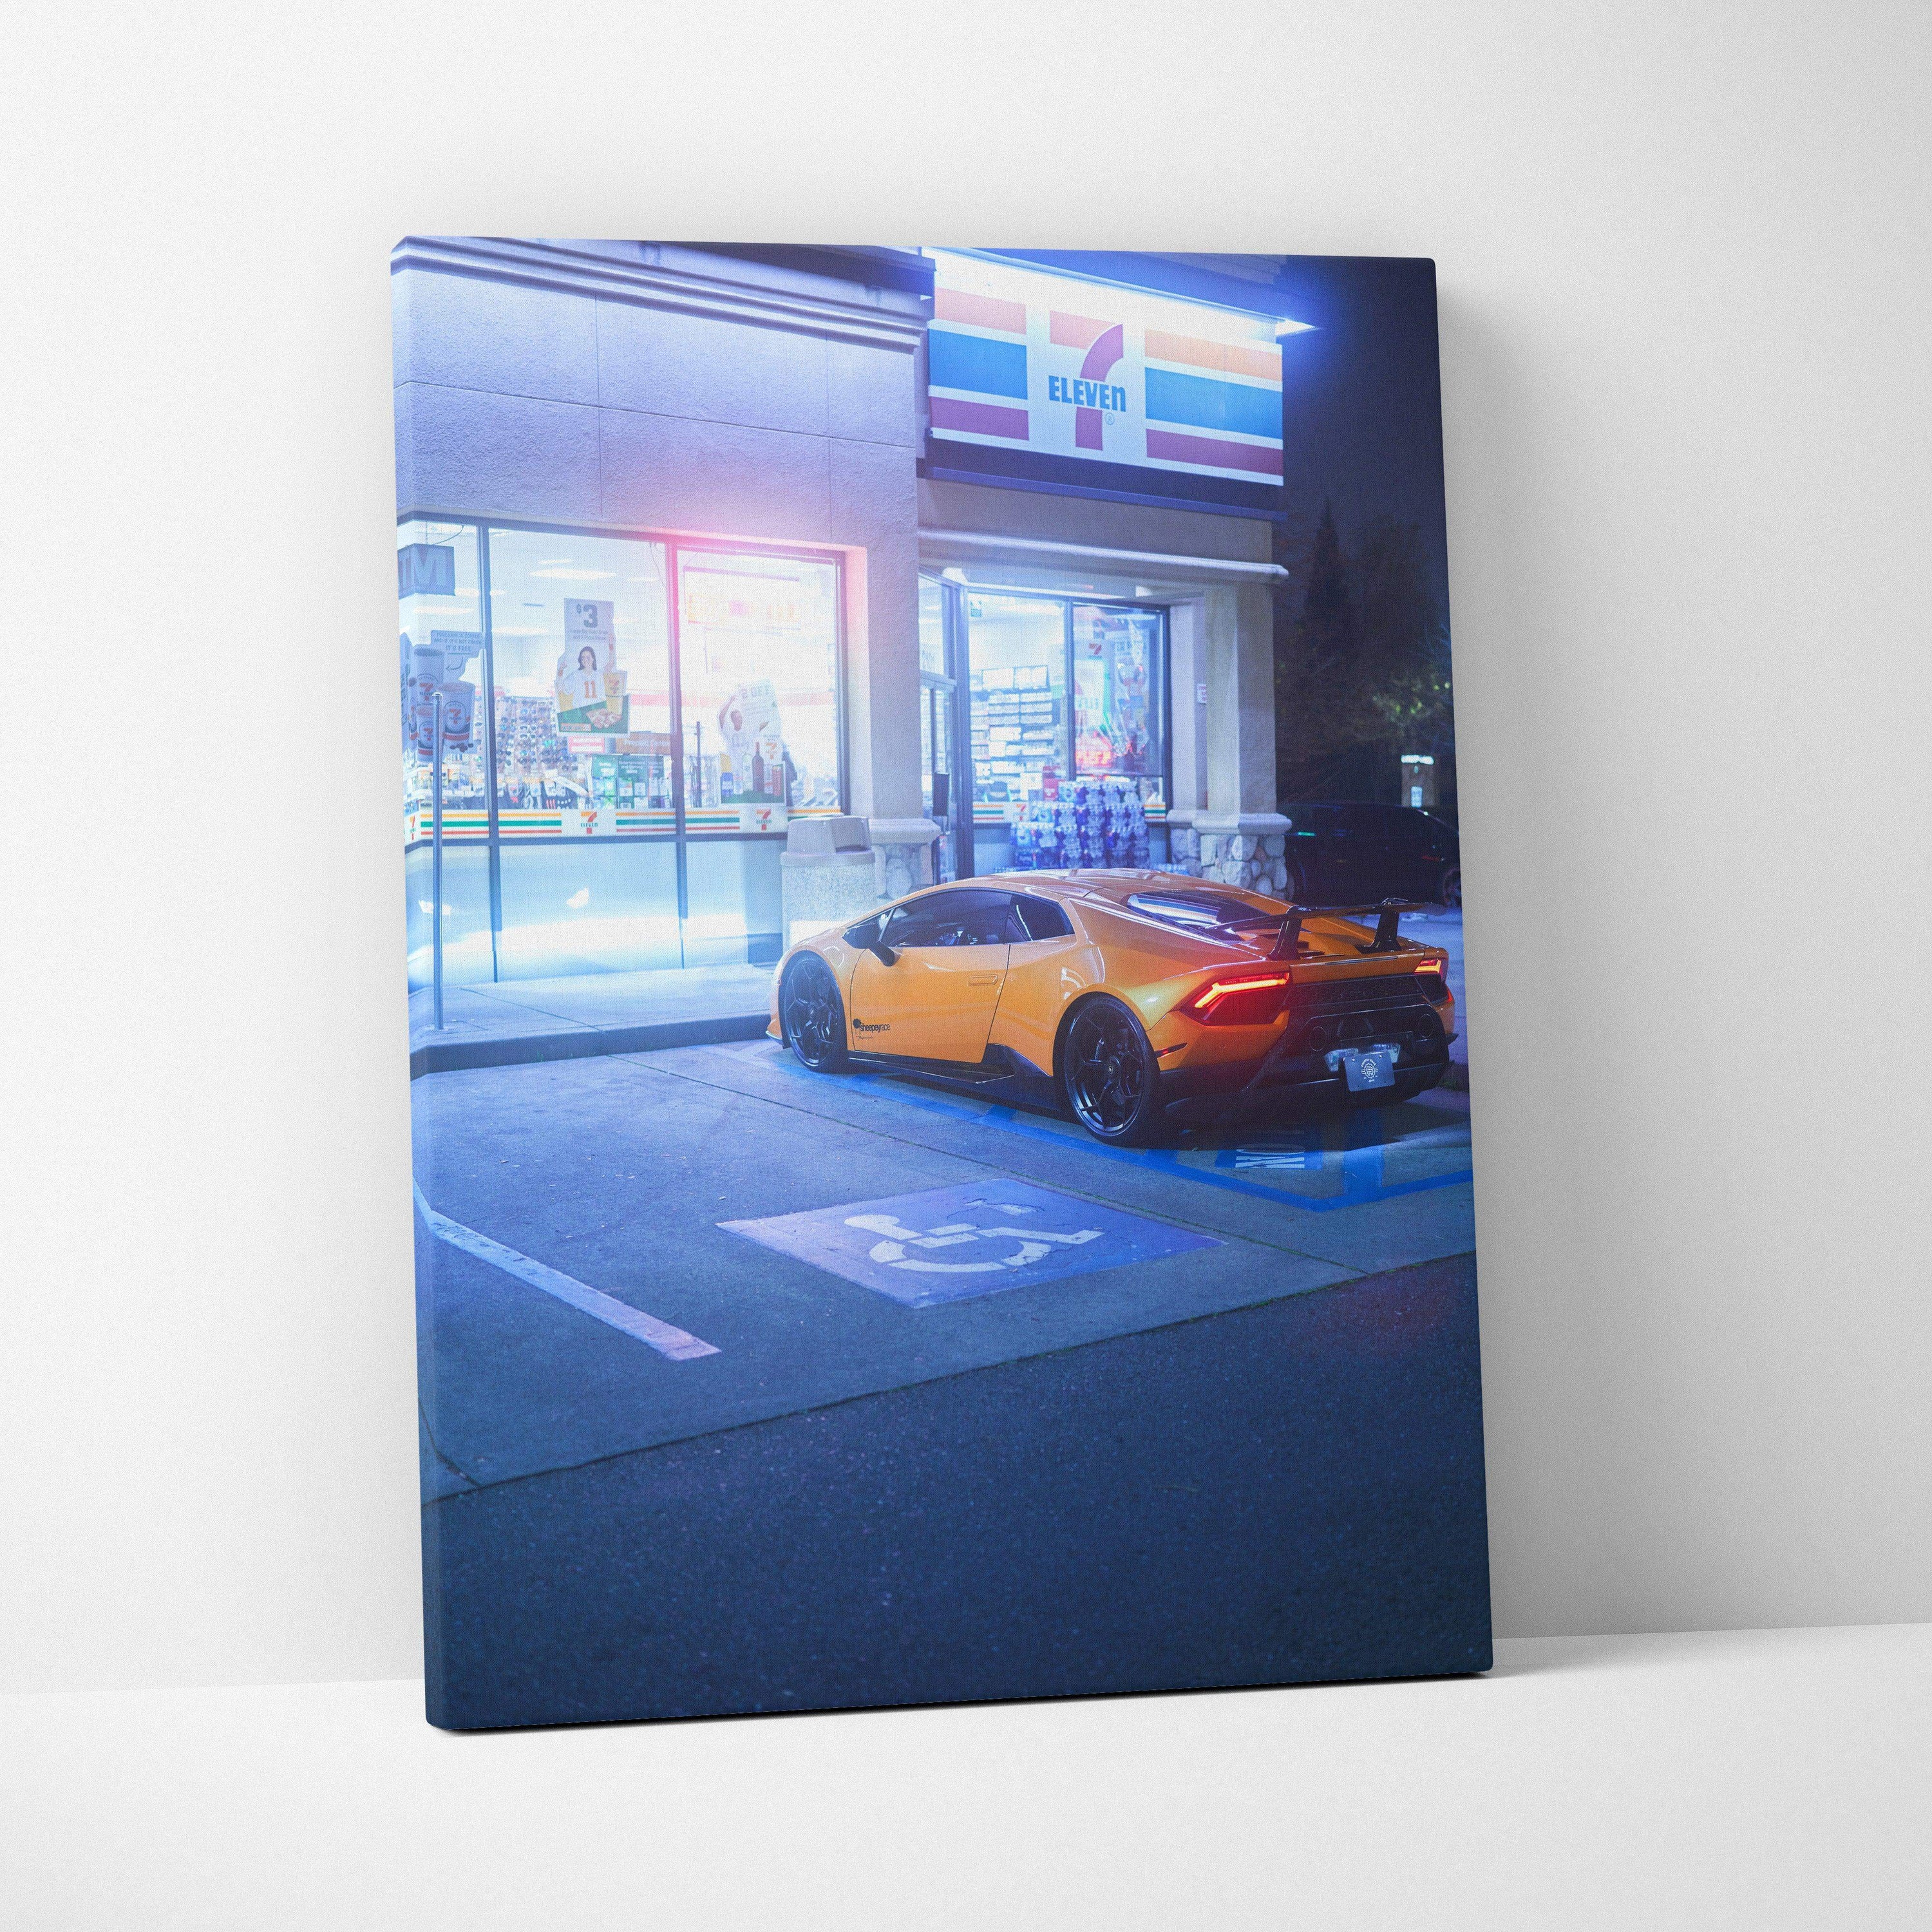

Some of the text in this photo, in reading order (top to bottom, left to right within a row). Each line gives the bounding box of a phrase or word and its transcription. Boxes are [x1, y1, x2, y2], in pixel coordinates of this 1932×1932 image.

[1050, 310, 1124, 451] 7
[576, 603, 598, 629] $3
[580, 811, 598, 835] 7
